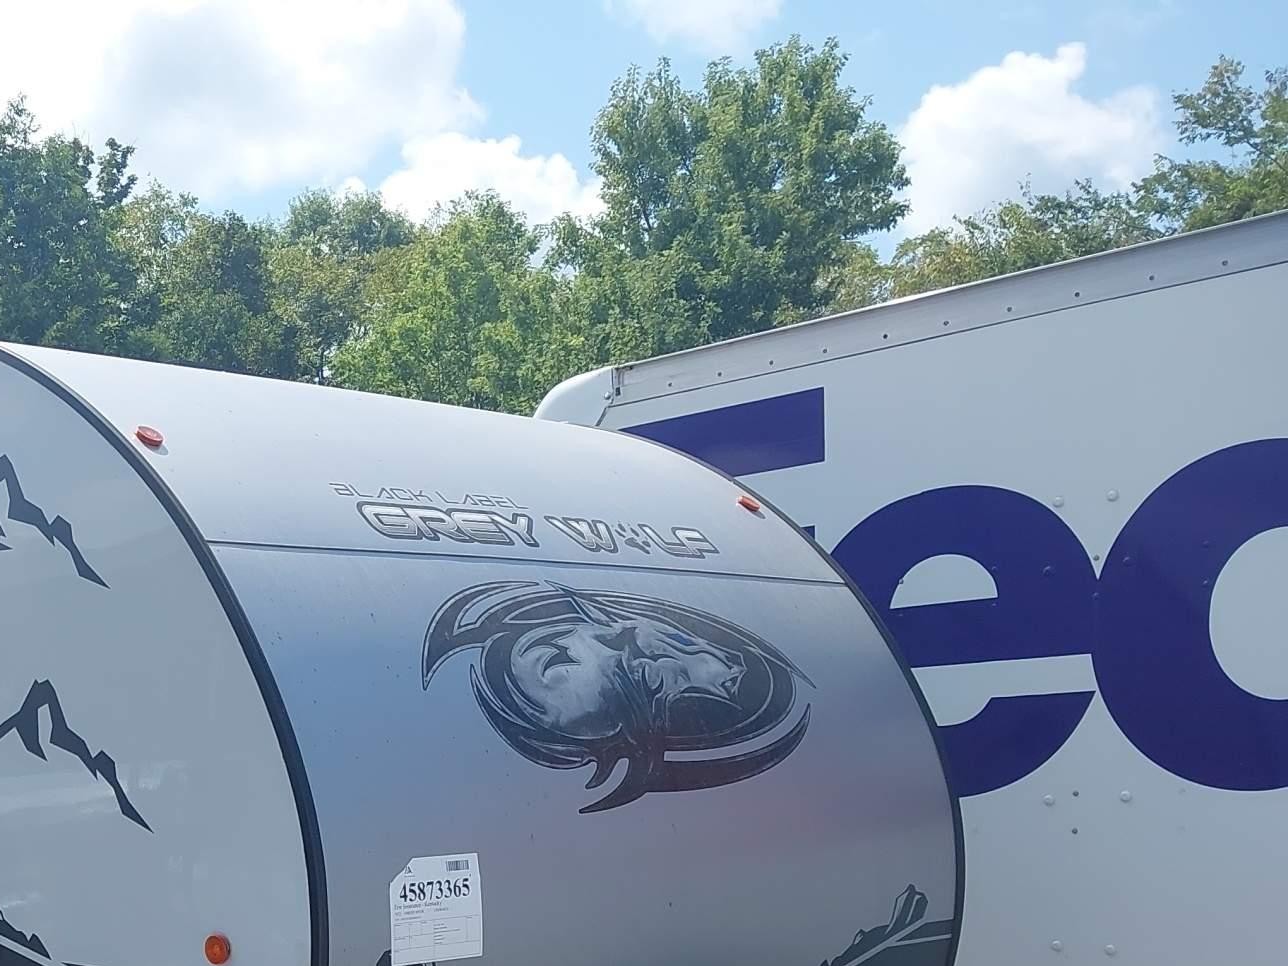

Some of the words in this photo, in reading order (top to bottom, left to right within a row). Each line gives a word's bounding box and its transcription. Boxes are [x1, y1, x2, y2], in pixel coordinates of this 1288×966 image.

[329, 482, 434, 502] BLACK
[437, 486, 529, 510] LABEL
[355, 500, 541, 548] GREY
[399, 877, 471, 903] 45873365
